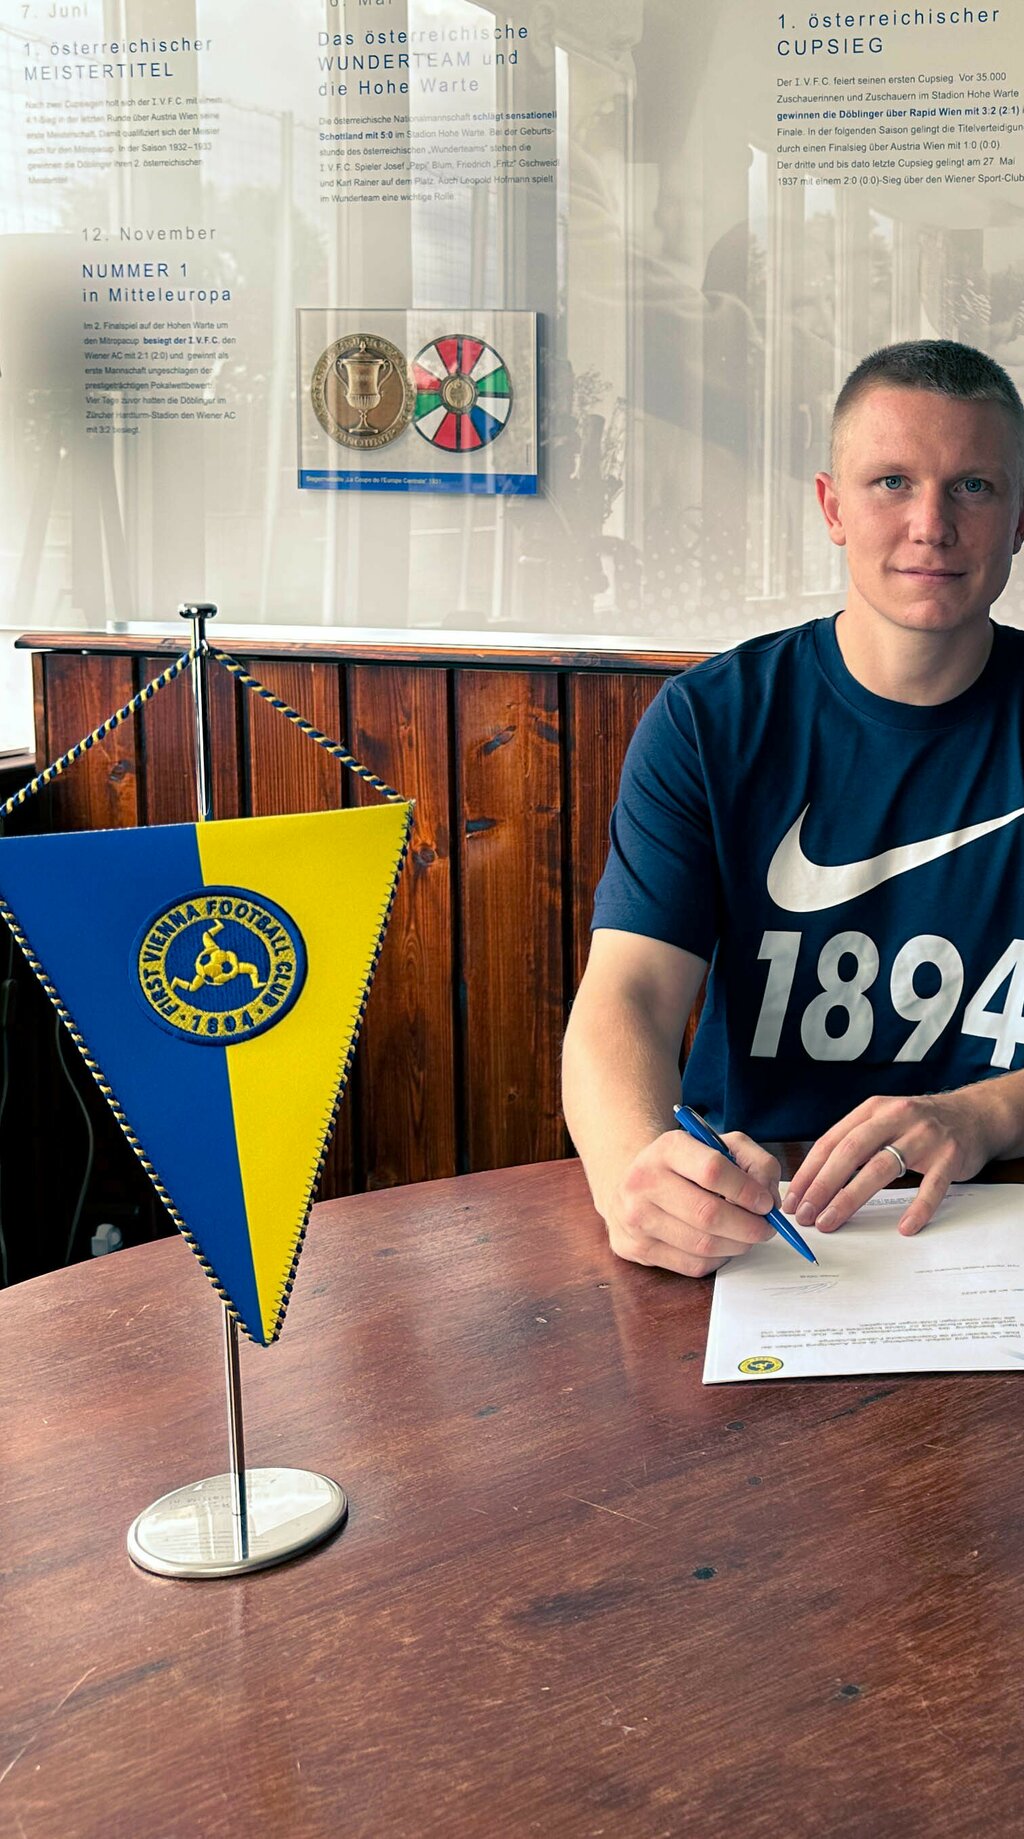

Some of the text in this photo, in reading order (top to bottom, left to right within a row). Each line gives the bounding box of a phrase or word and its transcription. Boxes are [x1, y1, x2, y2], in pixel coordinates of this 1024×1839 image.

[21, 3, 88, 19] 7. Juni
[778, 8, 1000, 30] 1. österreichischer
[318, 25, 528, 46] Das österreichische
[25, 37, 212, 57] 1. österreichischer
[778, 37, 883, 56] CUPSIEG
[318, 50, 518, 71] WUNDERTEAM und
[25, 62, 174, 81] MEISTERTITEL
[319, 77, 479, 96] die Hohe Warte
[777, 89, 1019, 104] Zuschauerinnen und Zuschauern im Stadion Hohe Warte
[777, 111, 820, 122] gewinnen
[823, 110, 837, 119] die
[839, 109, 883, 120] Döblinger
[887, 108, 907, 118] über
[910, 107, 936, 118] Rapid
[939, 107, 962, 116] Wien
[965, 107, 980, 116] mit
[982, 106, 996, 115] 3:2
[999, 106, 1020, 117] (2:1)
[320, 131, 393, 141] Schottland mit 5:0
[82, 226, 216, 242] 12. November
[82, 263, 188, 278] NUMMER 1
[83, 287, 232, 304] in Mitteleuropa
[84, 322, 93, 330] Im
[104, 321, 138, 332] Finalspiel
[139, 321, 151, 330] auf
[153, 321, 165, 330] der
[167, 321, 191, 330] Hohen
[193, 321, 215, 330] Warte
[143, 900, 293, 1017] FIRST VIENNA FOOTBALL CLUB
[193, 1010, 255, 1034] 1894
